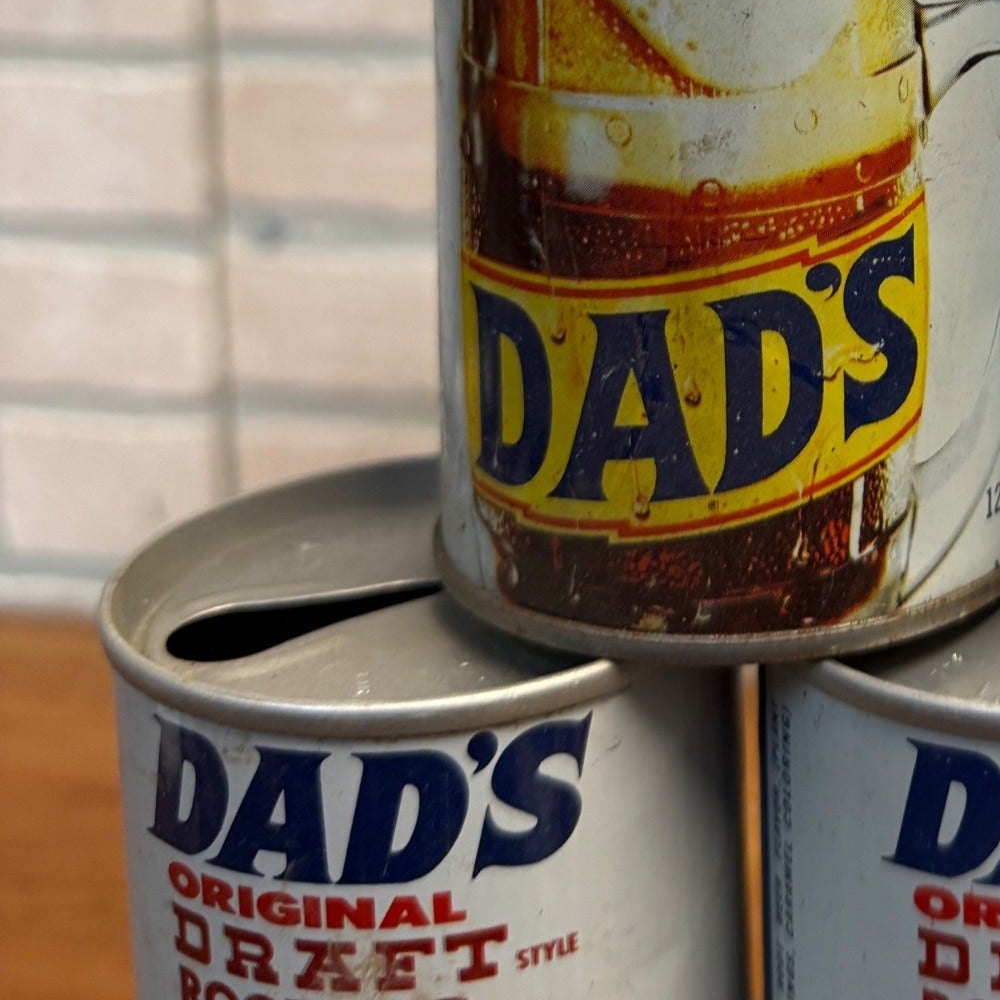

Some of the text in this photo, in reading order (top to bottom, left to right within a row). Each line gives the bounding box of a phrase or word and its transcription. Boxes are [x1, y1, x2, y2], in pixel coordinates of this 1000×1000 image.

[471, 224, 918, 501] DAD'S
[147, 710, 593, 885] DAD'S
[168, 861, 466, 930] ORIGINAL
[172, 902, 508, 993] DRAFT
[515, 932, 579, 973] STYLE
